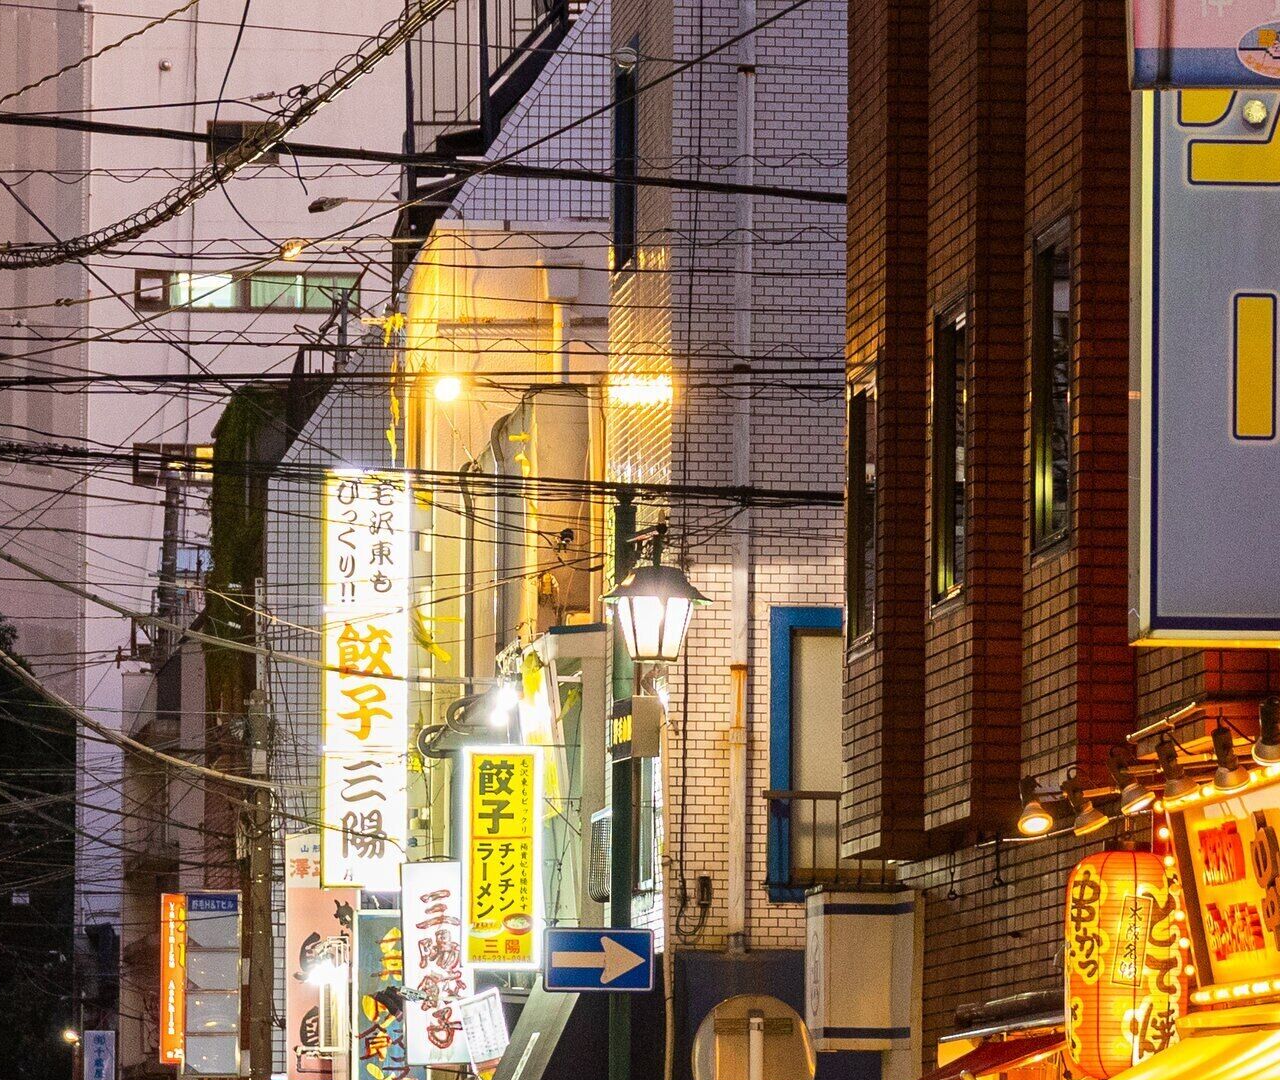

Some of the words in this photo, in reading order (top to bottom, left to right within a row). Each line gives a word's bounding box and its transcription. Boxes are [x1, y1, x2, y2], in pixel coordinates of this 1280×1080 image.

[337, 621, 394, 741] 餃子
[340, 760, 388, 859] 三陽
[478, 760, 515, 834] 餃子
[477, 842, 495, 919] ラーメン
[499, 842, 515, 912] チンチン
[484, 939, 521, 954] 三陽
[1071, 869, 1104, 978] 串かつ
